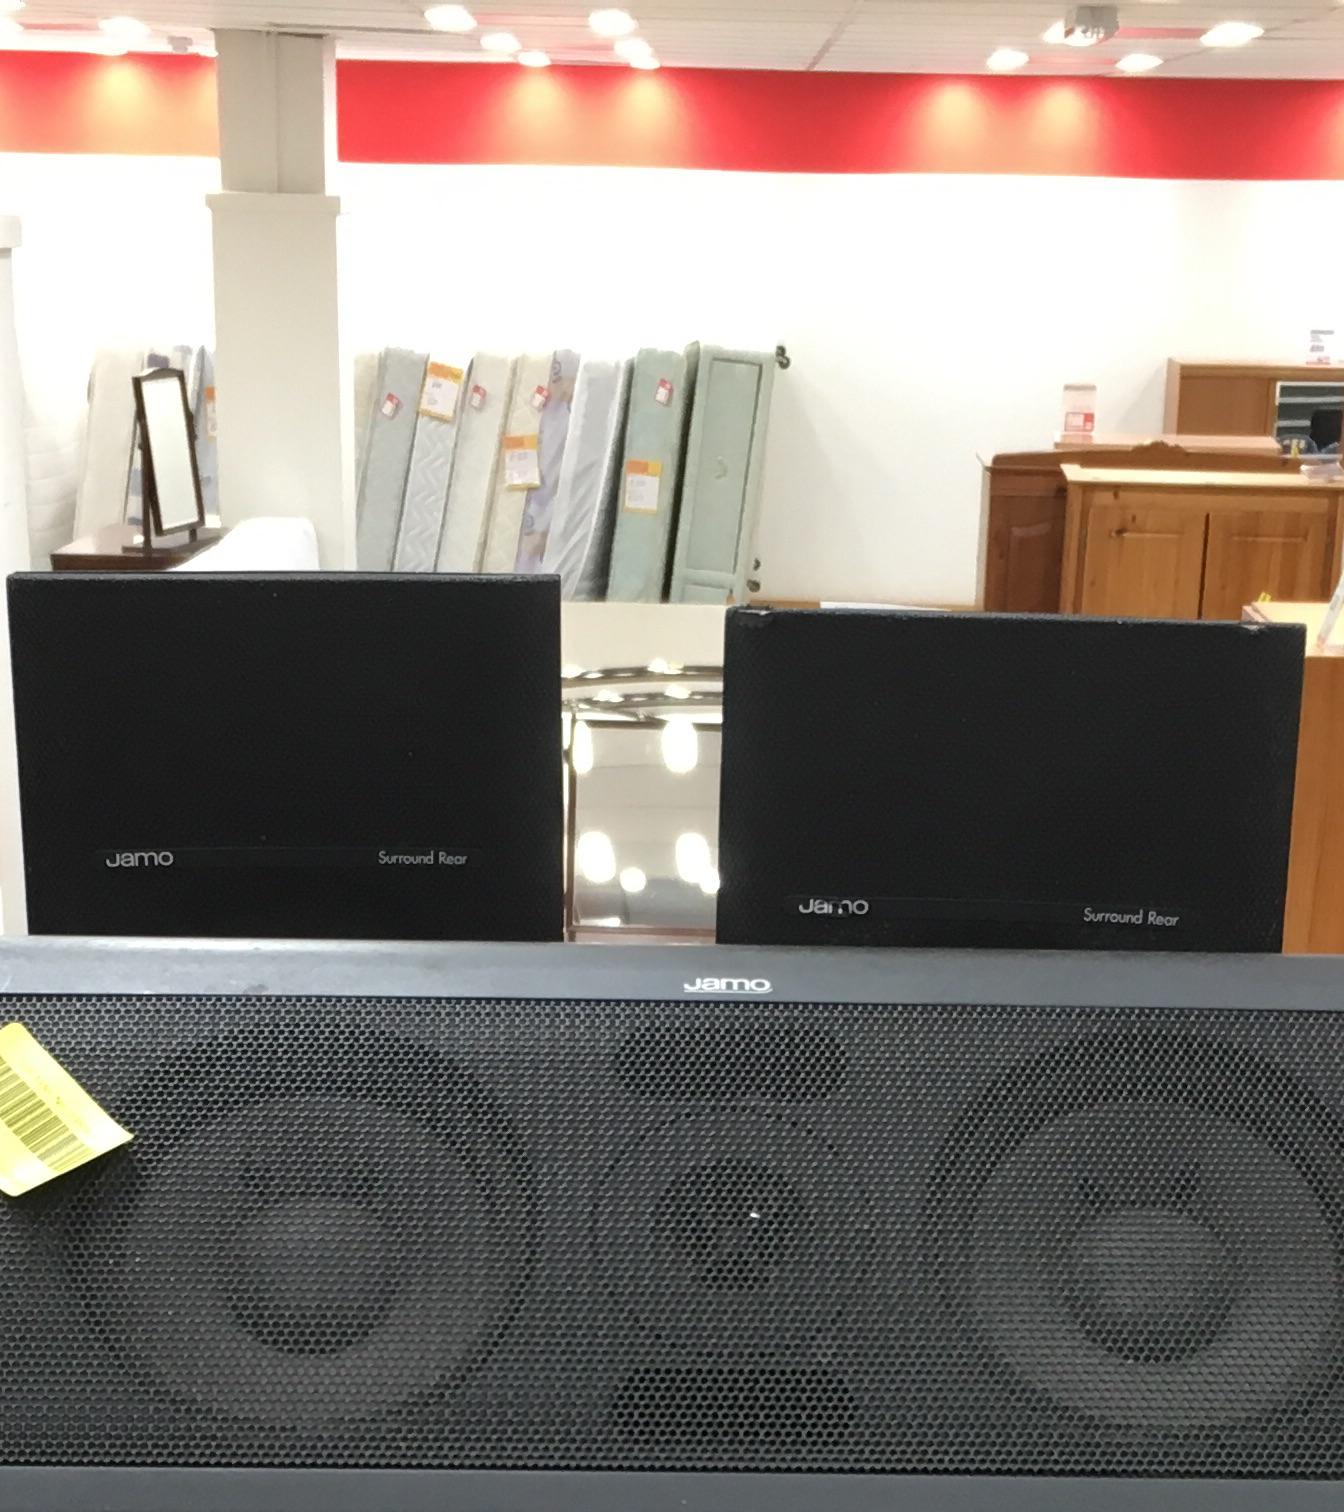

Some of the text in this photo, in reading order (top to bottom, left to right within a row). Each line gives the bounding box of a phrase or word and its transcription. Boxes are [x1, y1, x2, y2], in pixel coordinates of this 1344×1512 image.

[378, 850, 468, 866] Surround Rear
[1083, 907, 1180, 928] Surround Rear
